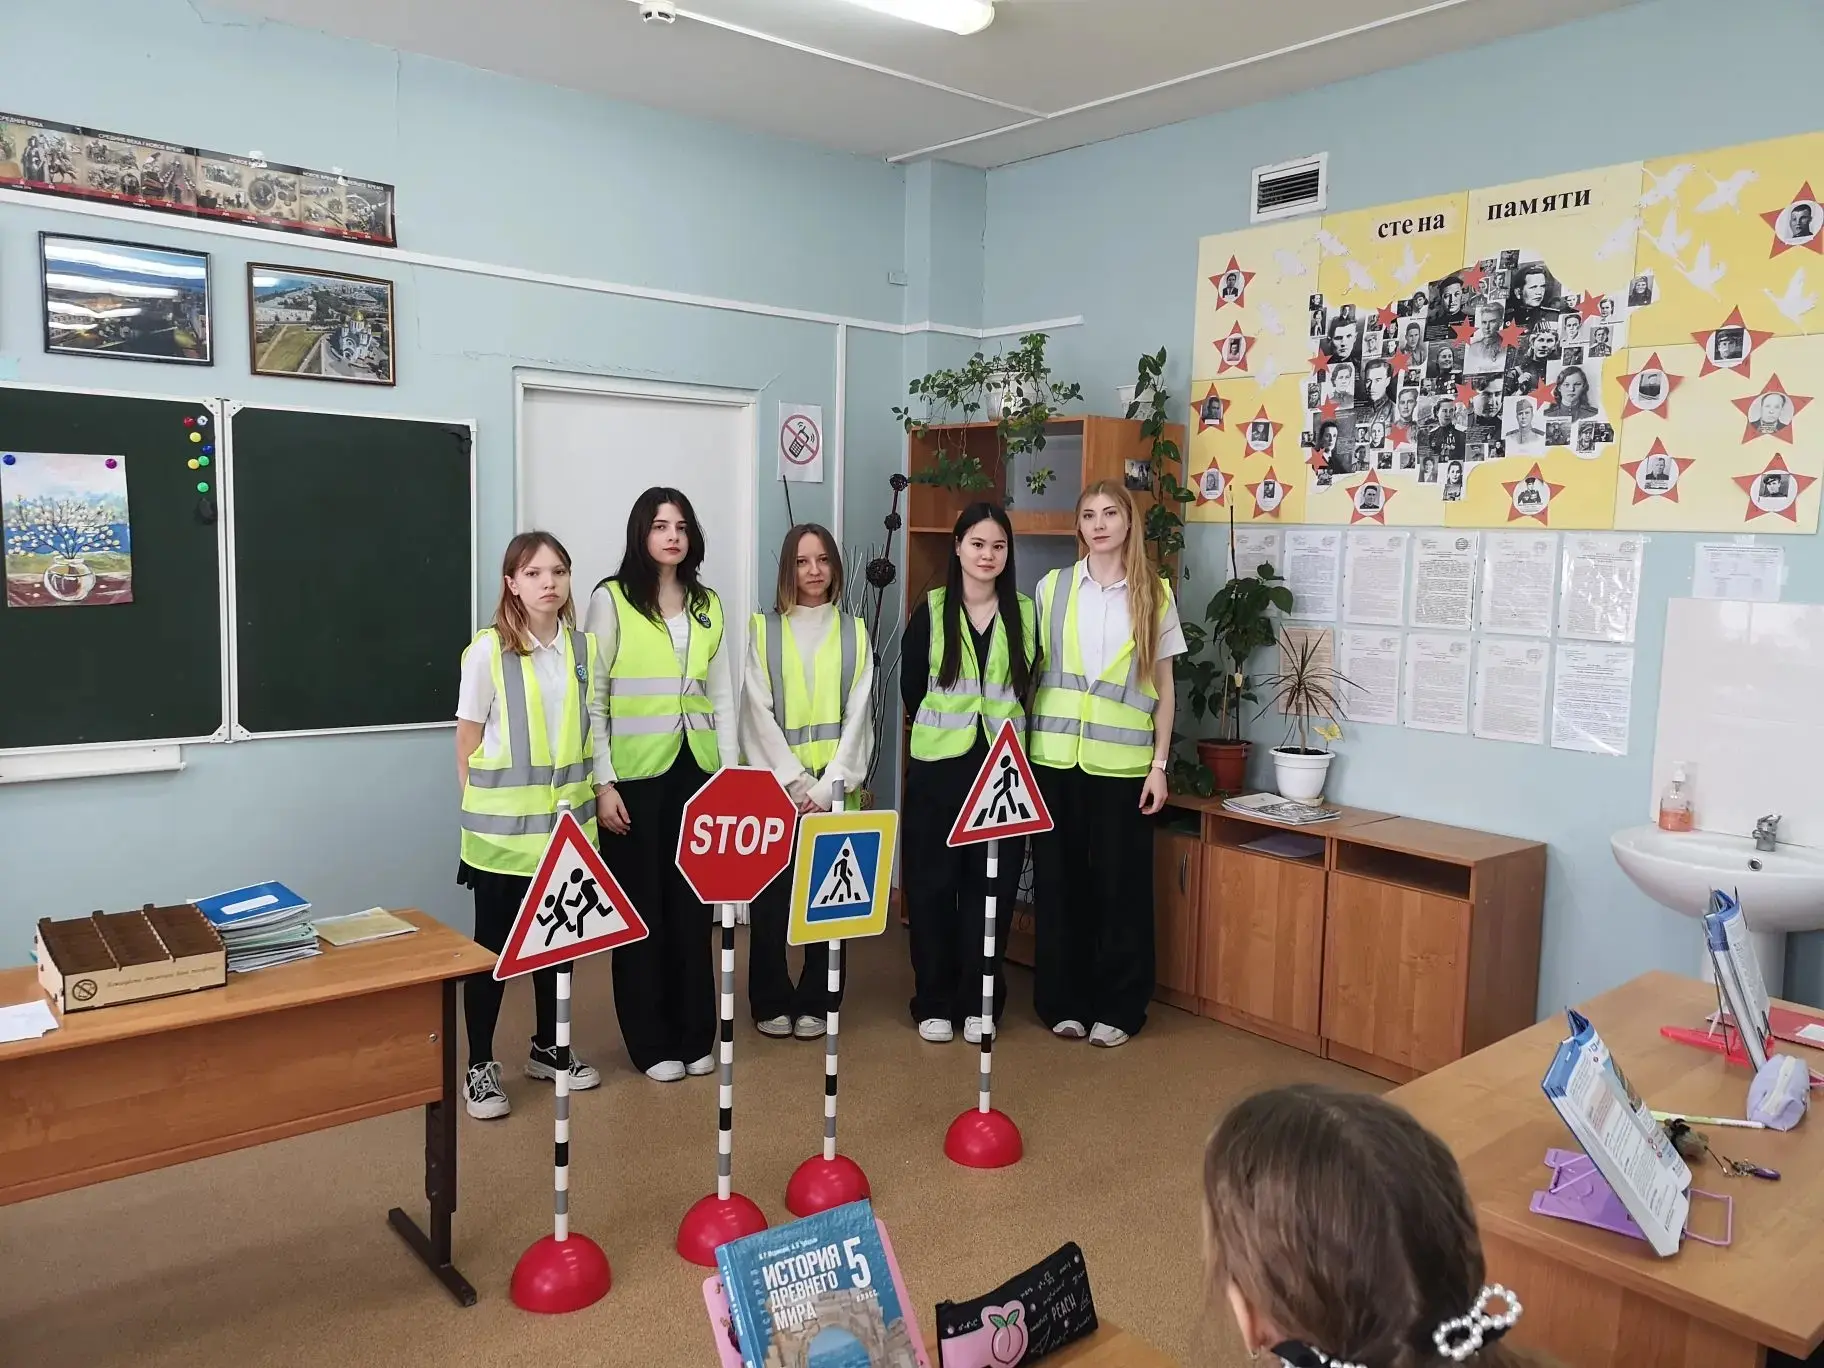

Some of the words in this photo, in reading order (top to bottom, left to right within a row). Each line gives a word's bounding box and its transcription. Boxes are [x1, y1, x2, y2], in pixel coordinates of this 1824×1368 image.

[1487, 189, 1592, 221] памяти
[690, 814, 785, 856] STOP
[762, 1243, 842, 1291] ИСТОРИЯ
[843, 1236, 872, 1289] 5
[769, 1270, 839, 1313] ДРЕВНЕГО
[1051, 1293, 1077, 1321] PEACH
[773, 1301, 817, 1331] МИРА
